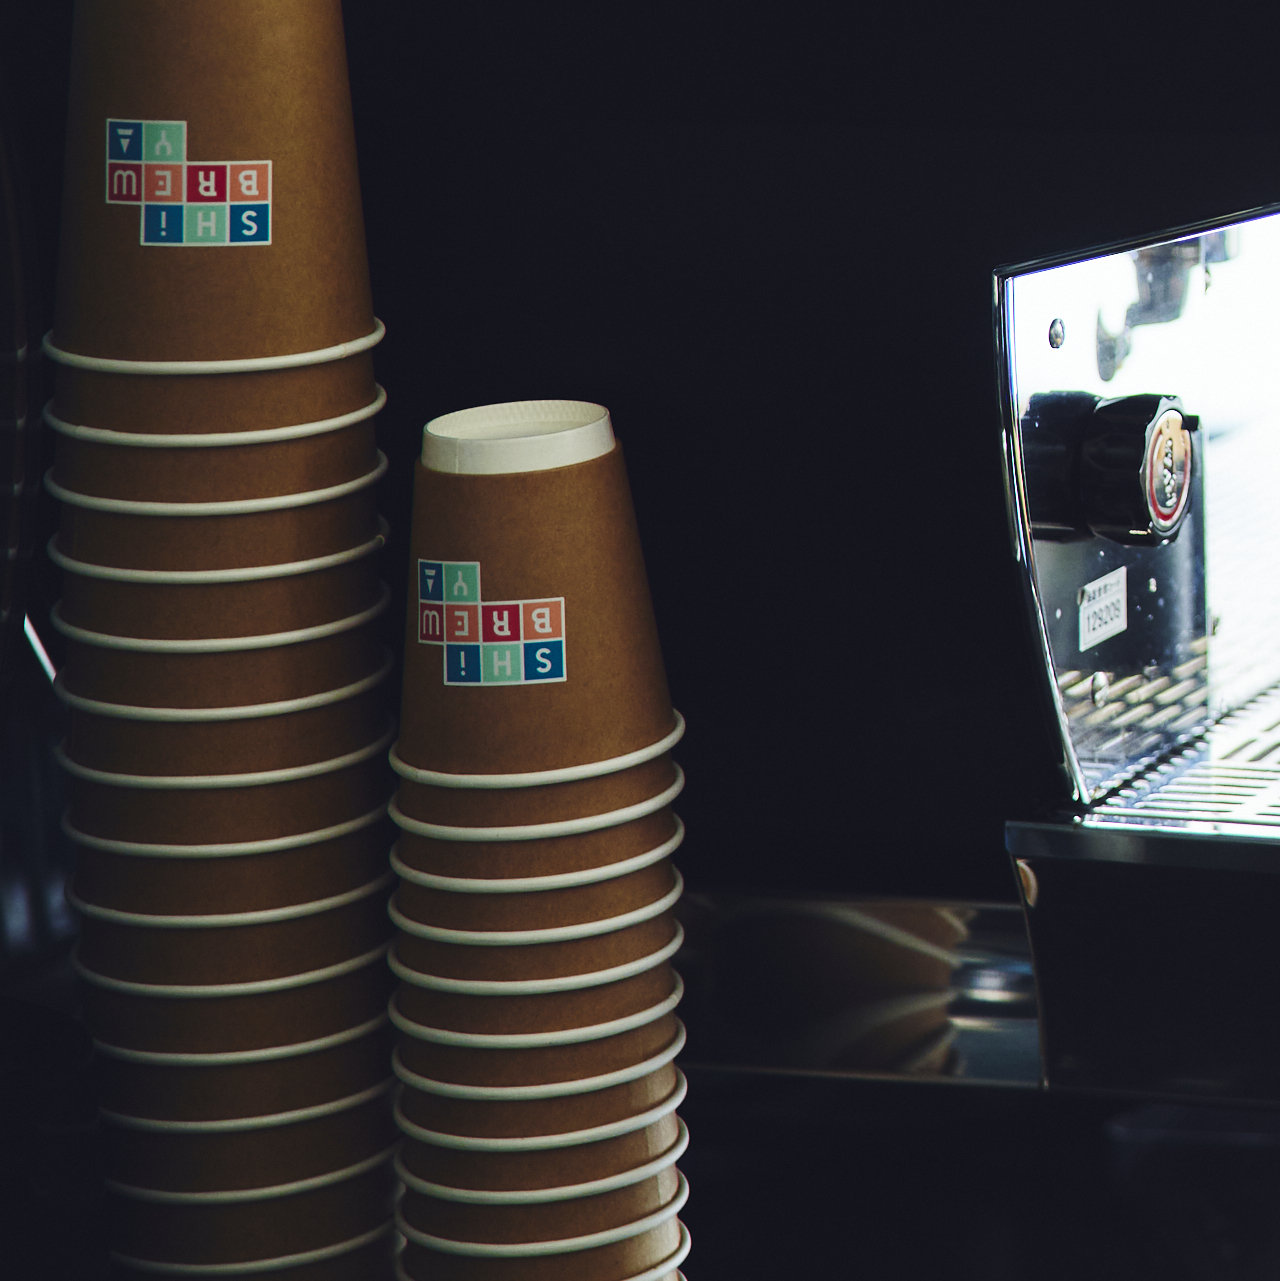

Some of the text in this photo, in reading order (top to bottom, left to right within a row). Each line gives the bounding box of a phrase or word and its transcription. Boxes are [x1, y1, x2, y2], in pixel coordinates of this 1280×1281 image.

[116, 128, 172, 156] YA
[113, 168, 260, 197] BREW
[424, 569, 468, 596] YA
[422, 607, 553, 637] BREW
